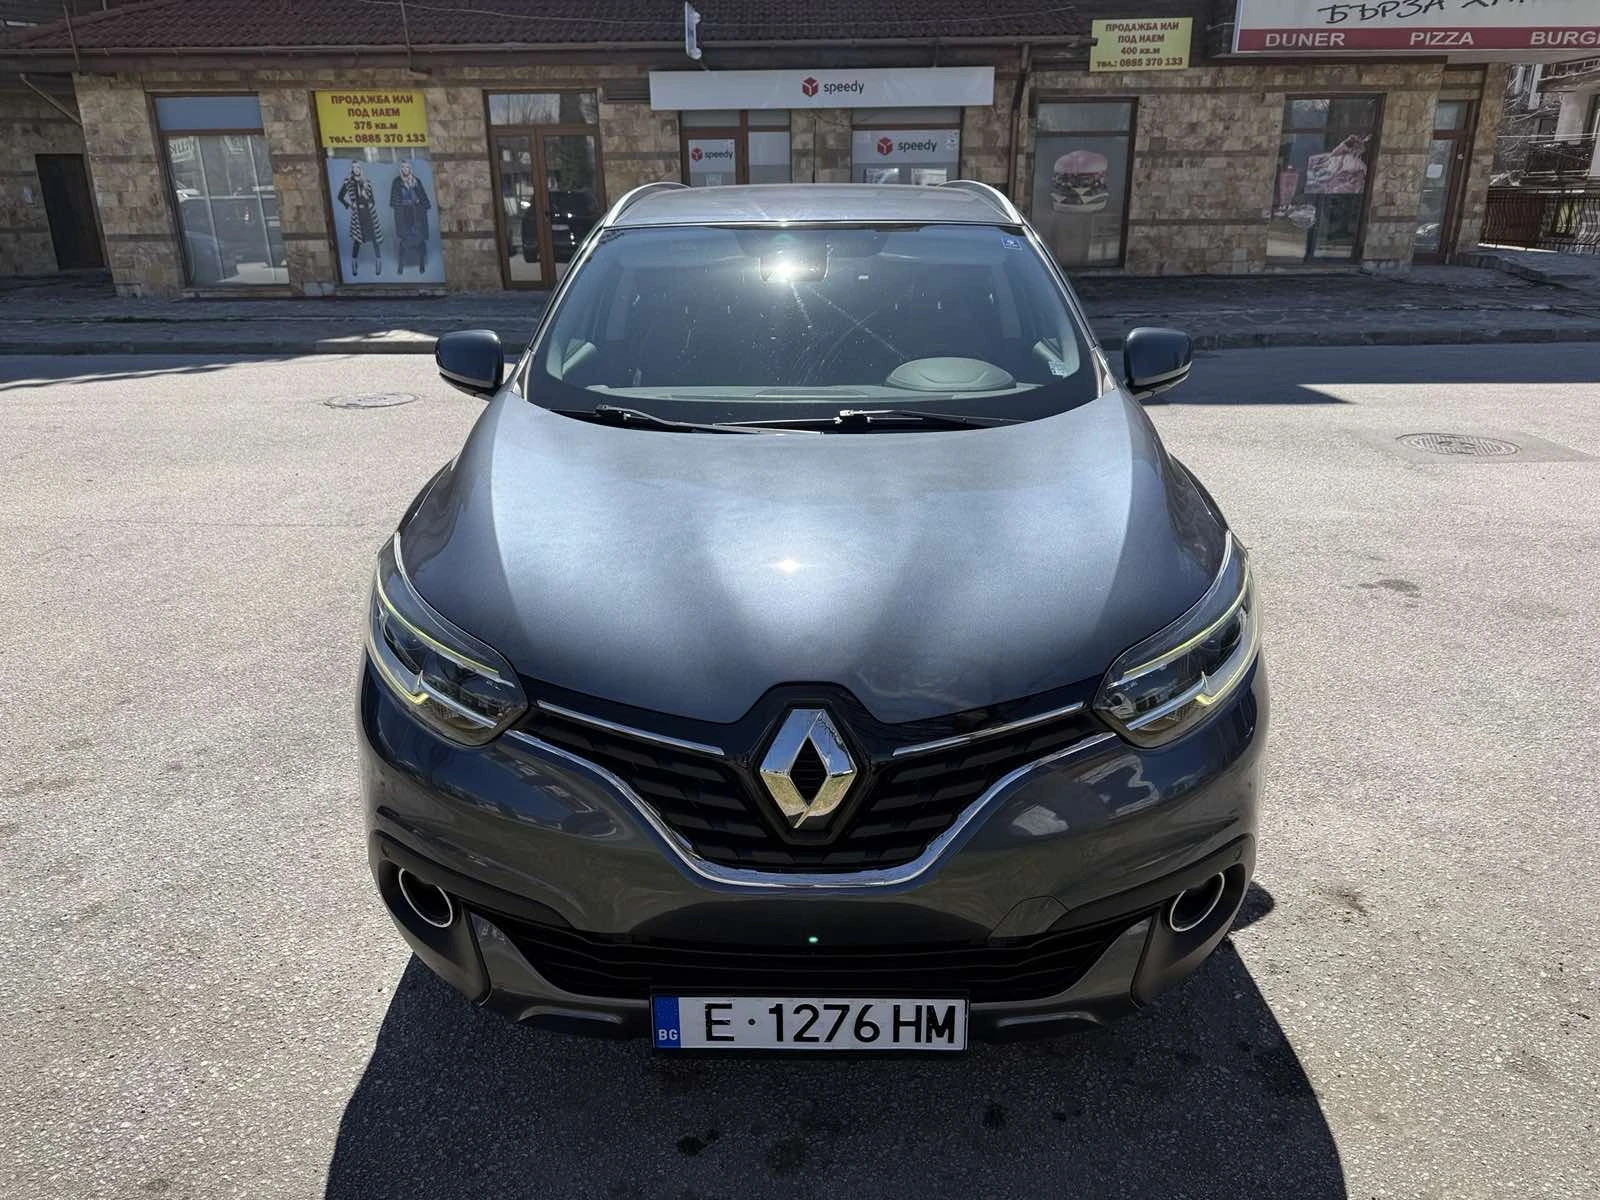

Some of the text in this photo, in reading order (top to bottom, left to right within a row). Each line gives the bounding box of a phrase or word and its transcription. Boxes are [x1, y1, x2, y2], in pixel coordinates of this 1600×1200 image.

[1105, 22, 1180, 32] ПРОДАЖБА ИЛИ
[1118, 34, 1165, 44] ПОД НАЕМ
[1265, 32, 1346, 47] DUNER
[1409, 31, 1474, 46] PIZZA
[1121, 46, 1137, 55] 400
[1145, 58, 1163, 66] 370
[1165, 57, 1183, 66] 133
[823, 80, 864, 95] speedy
[331, 95, 413, 105] ПРОДАЖБА ИЛИ
[347, 108, 400, 118] ПОД НАЕМ
[354, 121, 372, 130] 375
[355, 134, 381, 143] 0885
[384, 134, 403, 143] 370
[406, 134, 426, 142] 133
[898, 139, 938, 153] speedy
[704, 150, 733, 160] speedy
[768, 1003, 881, 1043] 1276
[892, 1004, 956, 1044] HM
[658, 1029, 679, 1041] BG
